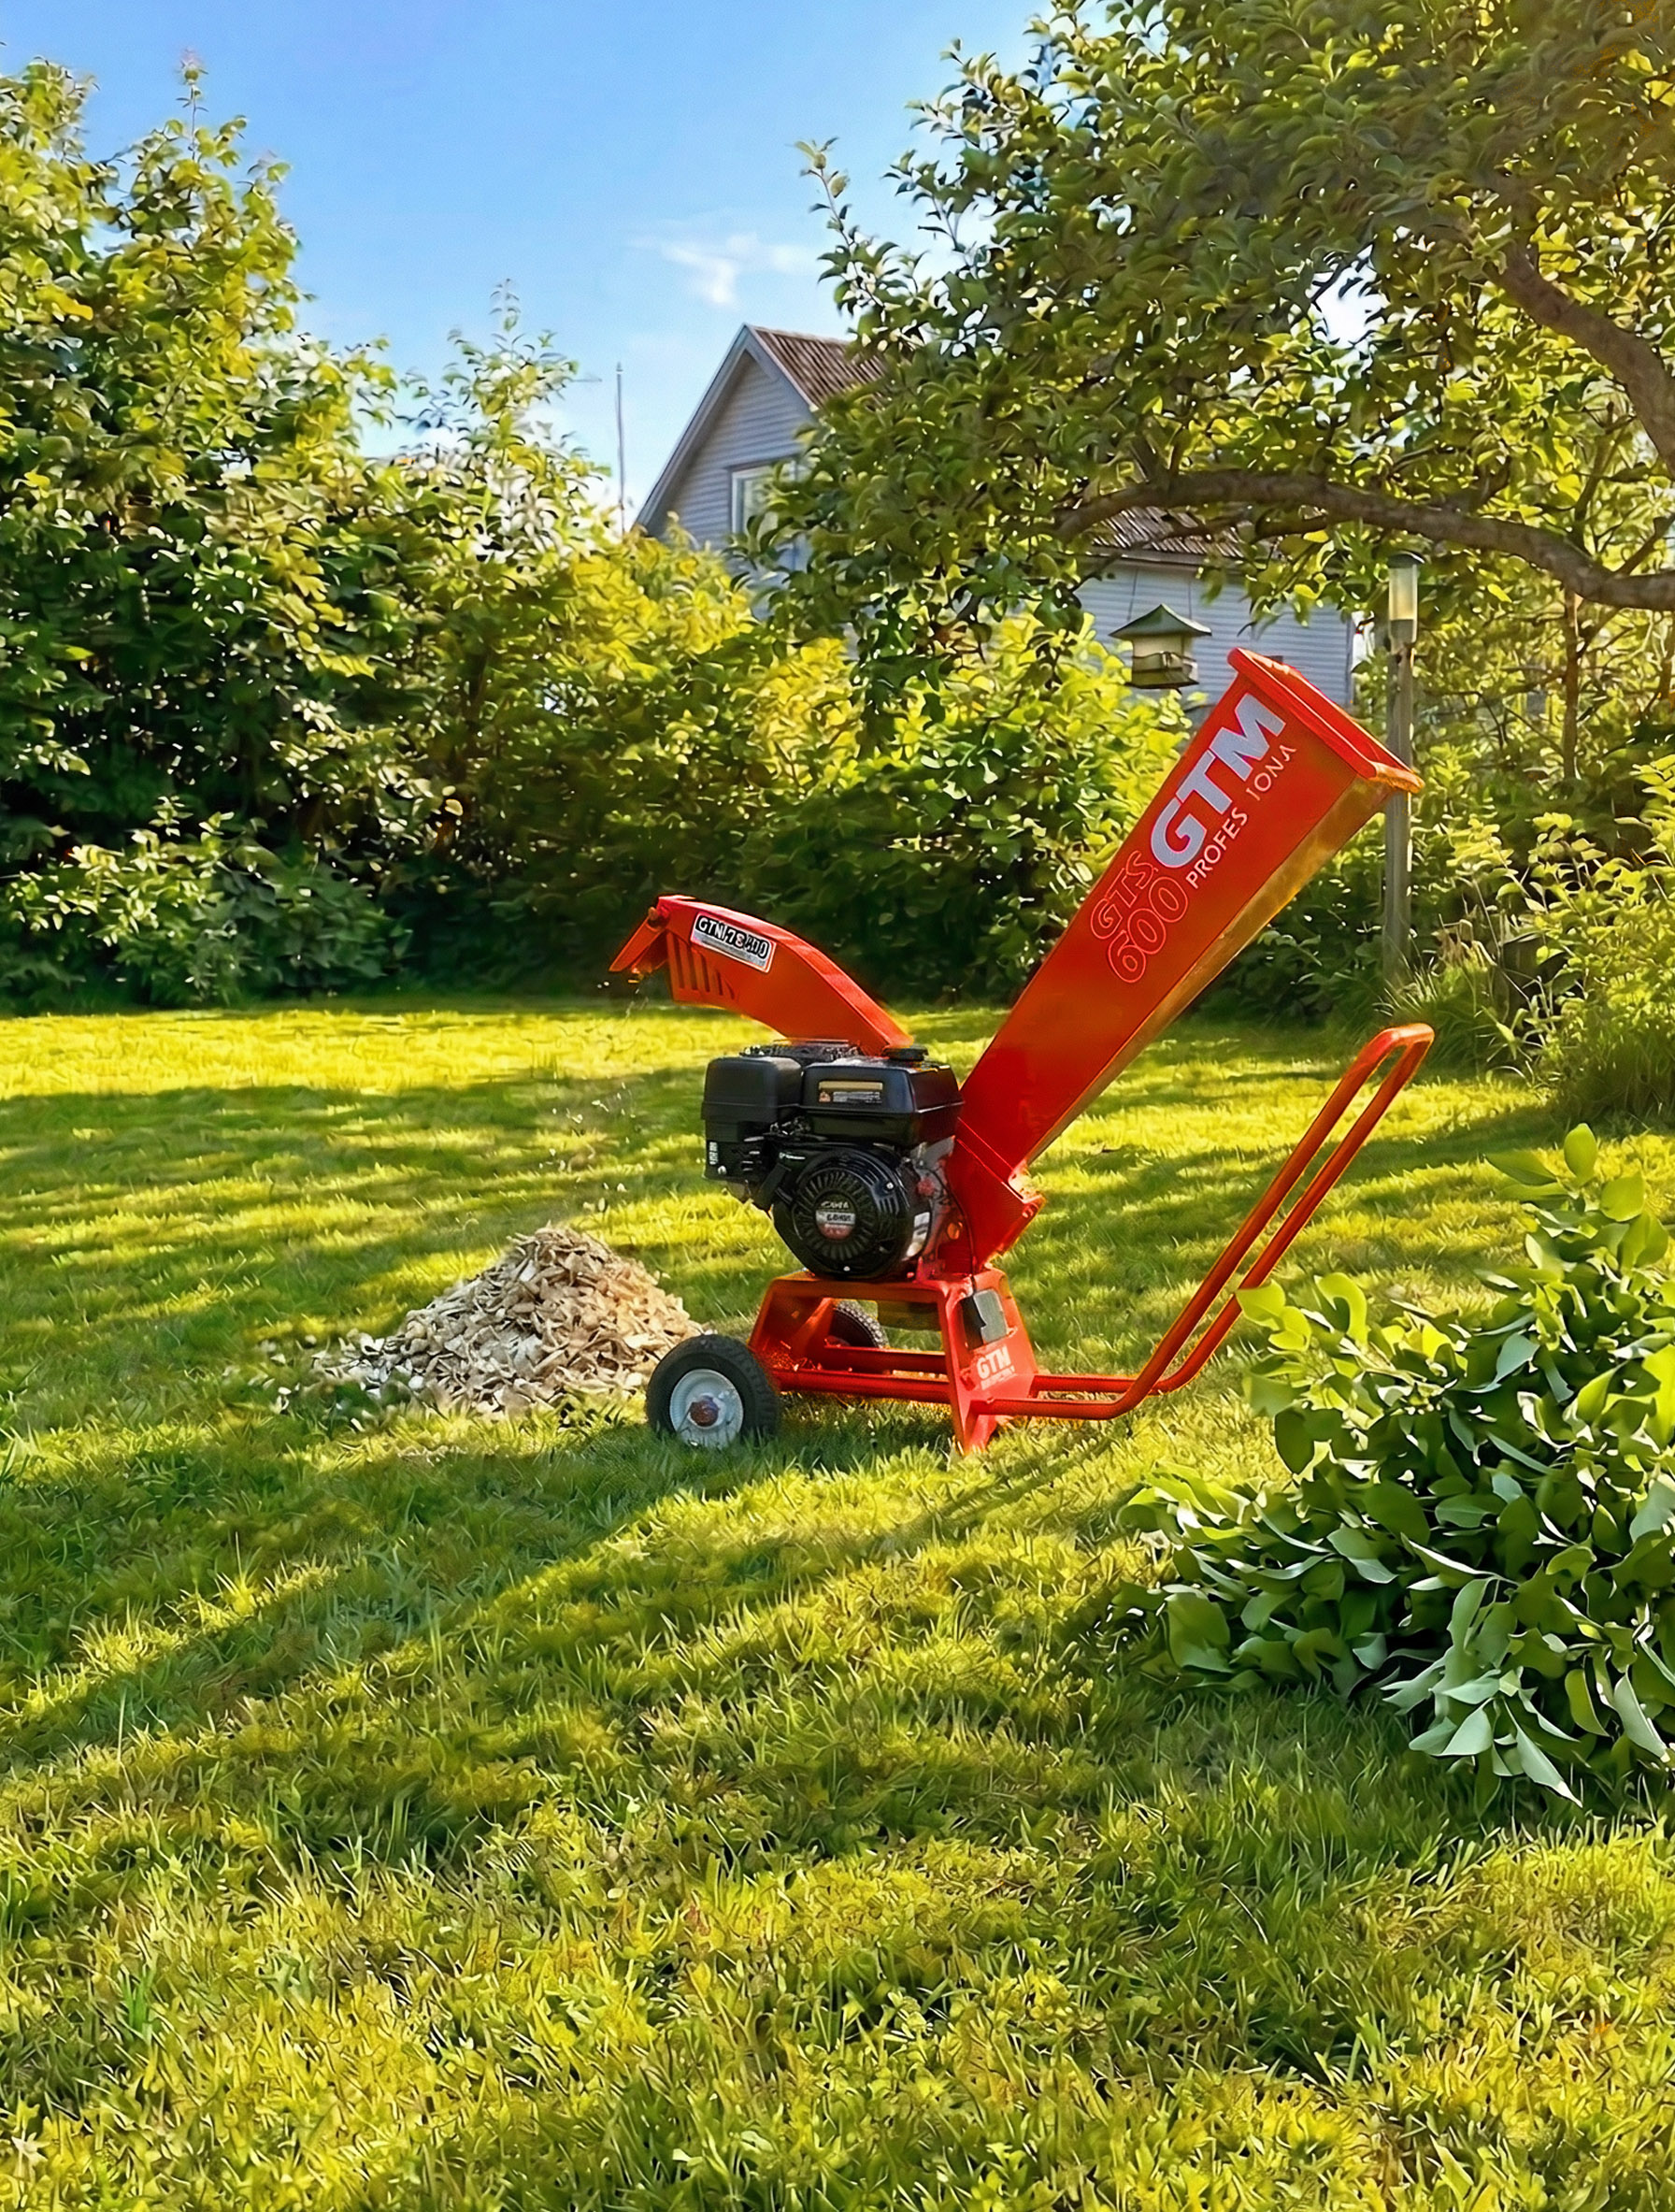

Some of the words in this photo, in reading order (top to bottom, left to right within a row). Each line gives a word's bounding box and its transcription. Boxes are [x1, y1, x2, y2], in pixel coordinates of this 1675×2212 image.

[1151, 693, 1286, 869] GTM
[1090, 850, 1156, 940] GTS
[1185, 807, 1249, 889] PROFES
[1108, 876, 1189, 984] 600
